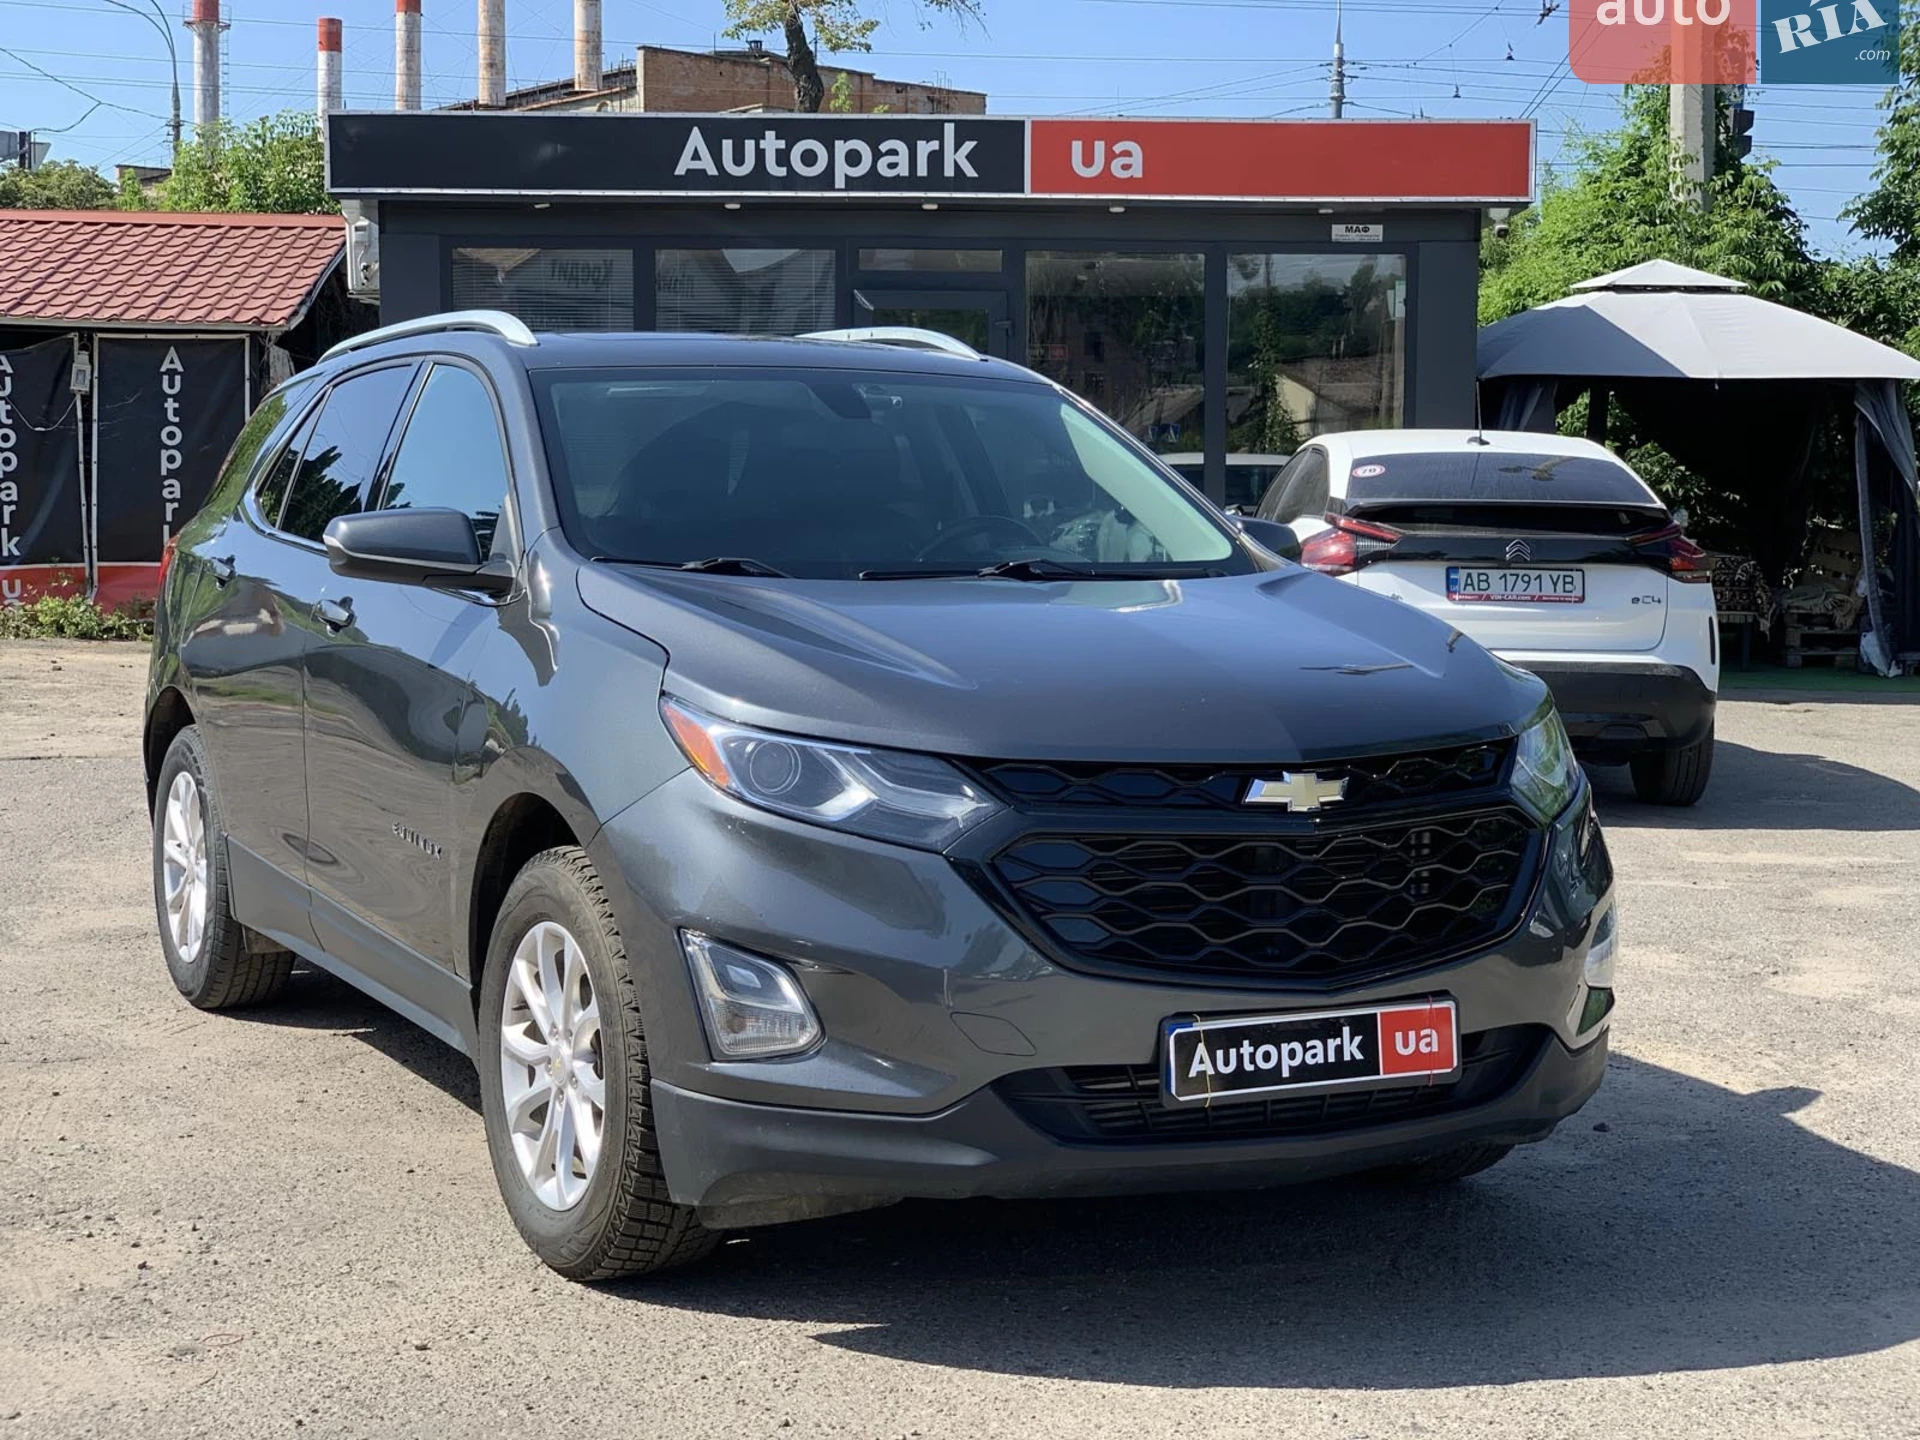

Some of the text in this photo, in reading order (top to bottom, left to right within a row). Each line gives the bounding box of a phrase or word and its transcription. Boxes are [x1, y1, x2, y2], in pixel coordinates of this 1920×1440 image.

[673, 122, 1144, 189] Autopark ua
[1463, 572, 1490, 592] AB
[1498, 573, 1542, 593] 1791
[1187, 1026, 1439, 1079] Autopark ua
